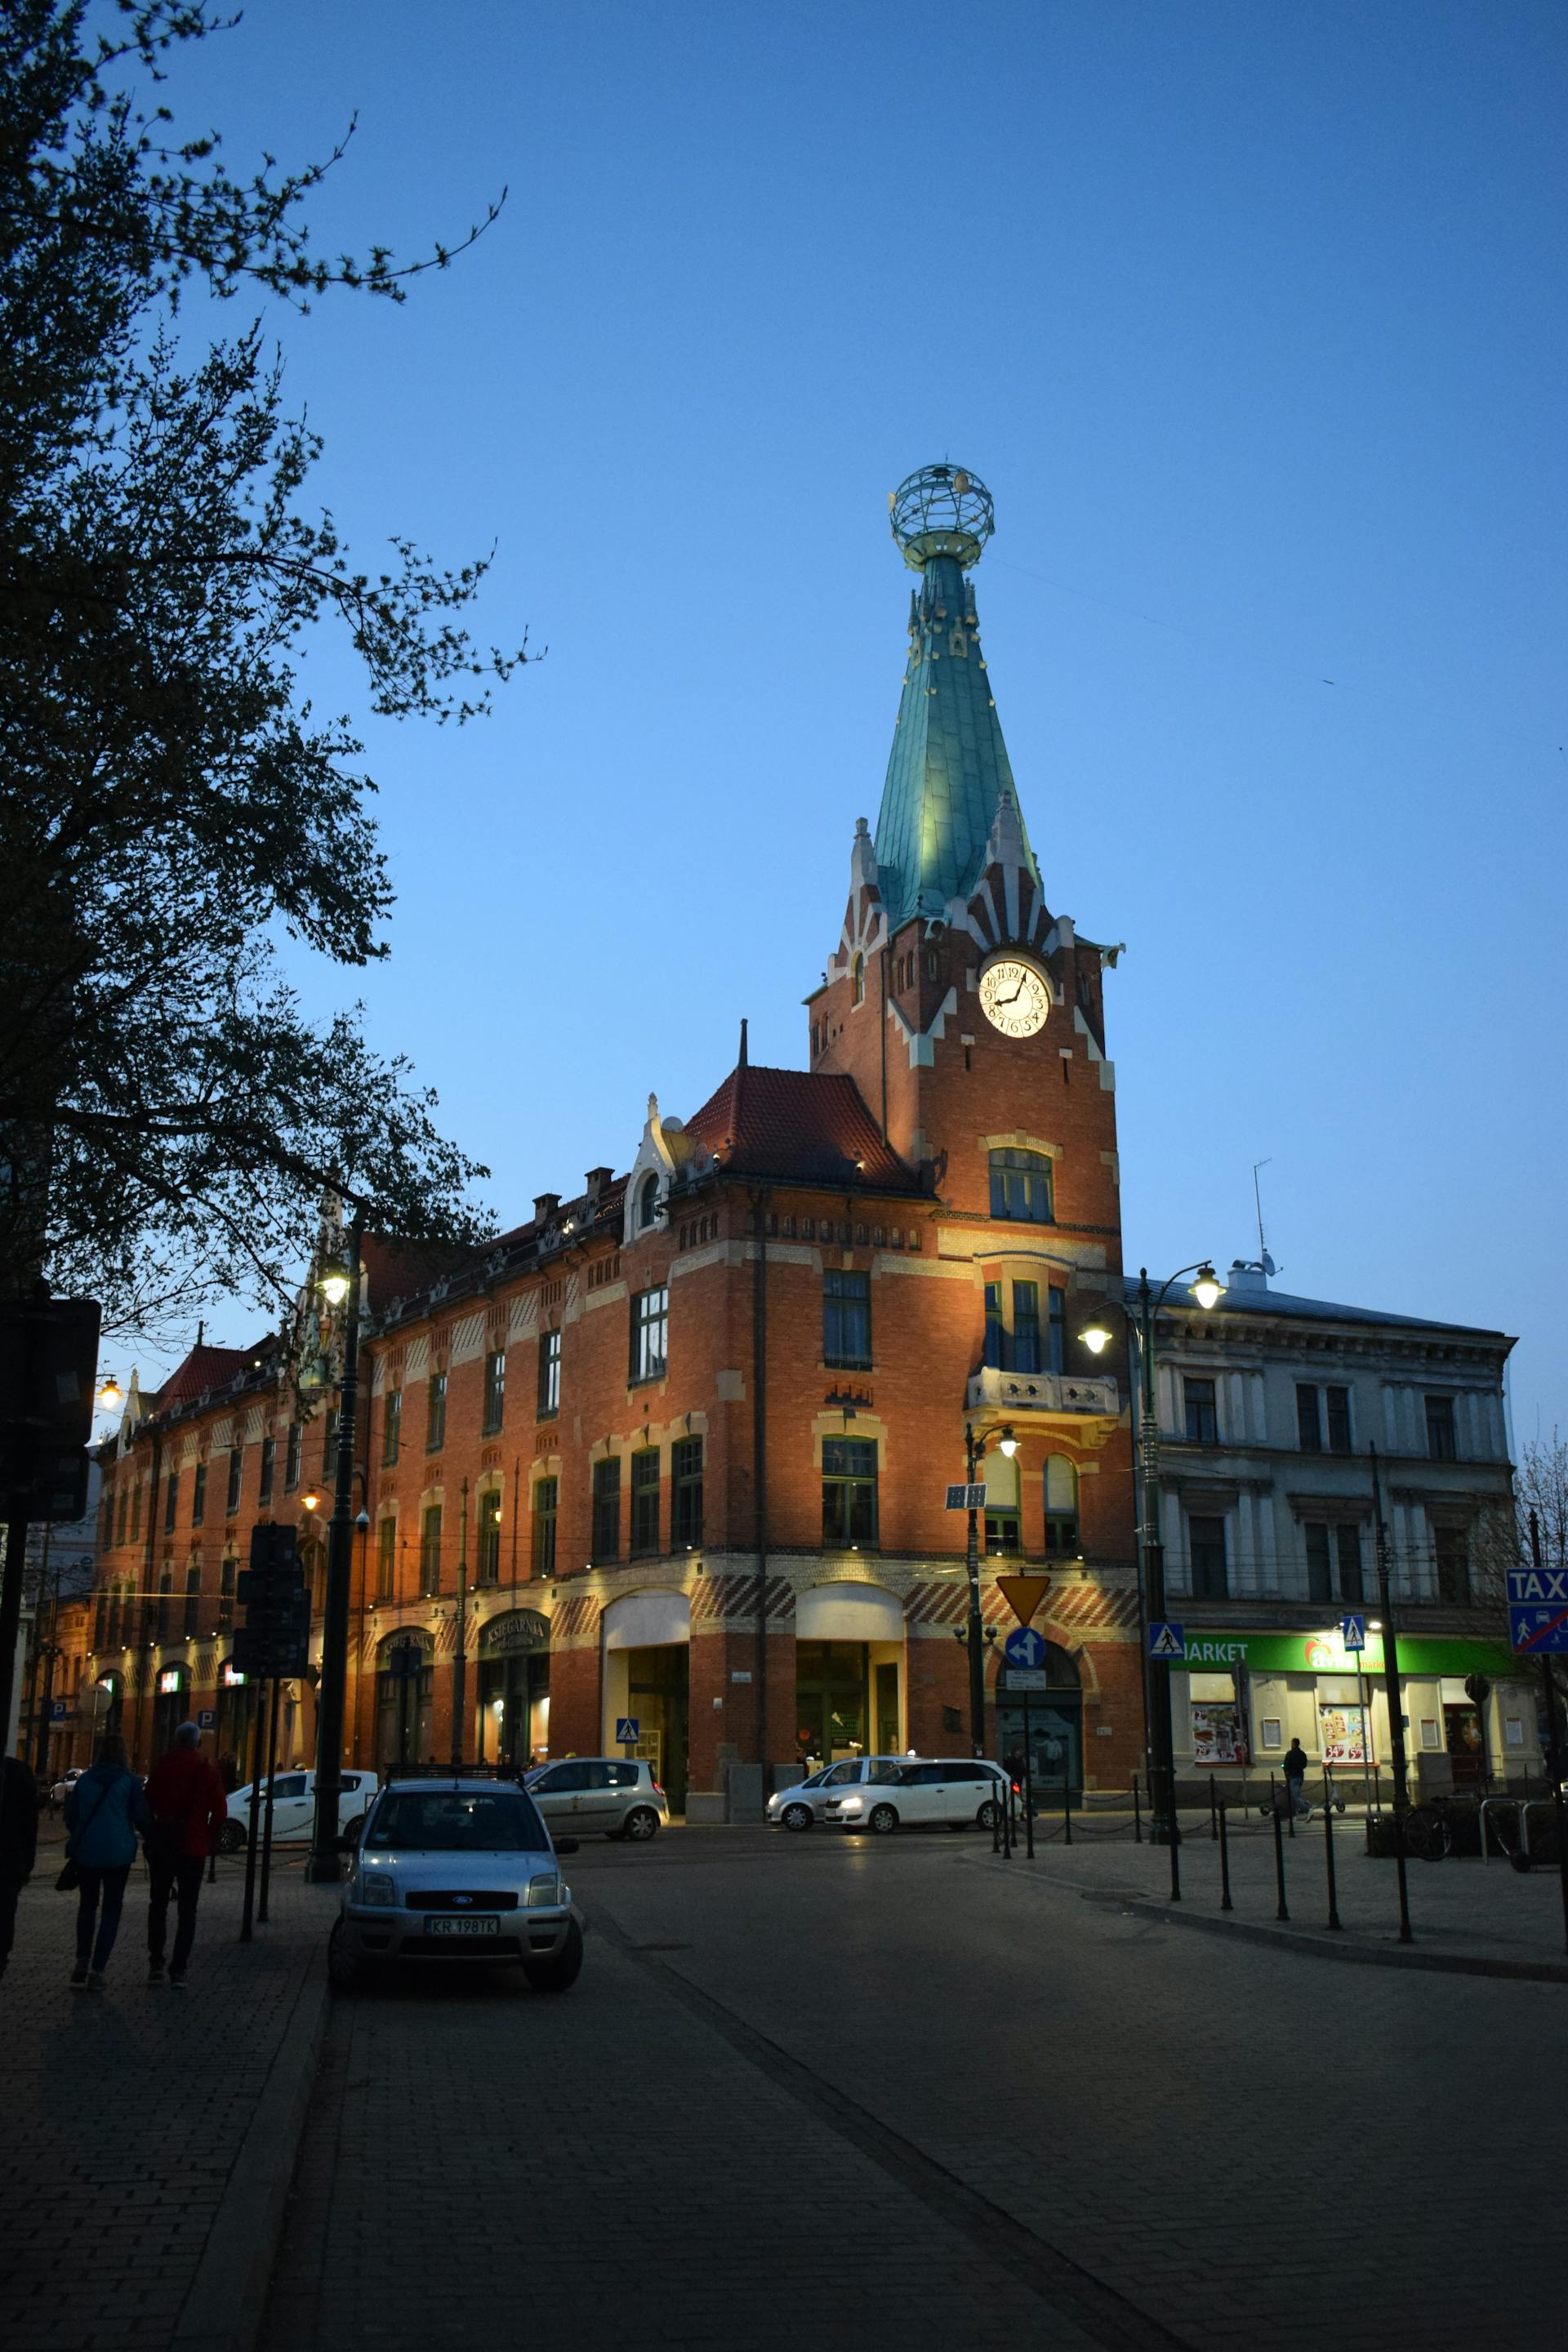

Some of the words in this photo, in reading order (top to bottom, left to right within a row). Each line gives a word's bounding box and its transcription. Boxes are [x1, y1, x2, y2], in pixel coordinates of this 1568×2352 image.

[997, 968, 1004, 979] 11
[1008, 967, 1019, 978] 12
[987, 976, 996, 988] 10
[1032, 983, 1040, 996] 2
[984, 990, 992, 1001] 9
[1036, 998, 1044, 1009] 3
[988, 1004, 996, 1018] 8
[999, 1017, 1005, 1027] 7
[1031, 1012, 1039, 1023] 4
[1010, 1021, 1018, 1033] 6
[1024, 1020, 1031, 1031] 5
[1508, 1572, 1568, 1599] TAX
[1358, 1659, 1386, 1670] marke
[53, 1704, 64, 1716] P
[202, 1712, 213, 1726] P
[433, 1920, 452, 1933] KR
[457, 1920, 495, 1933] 198TK
